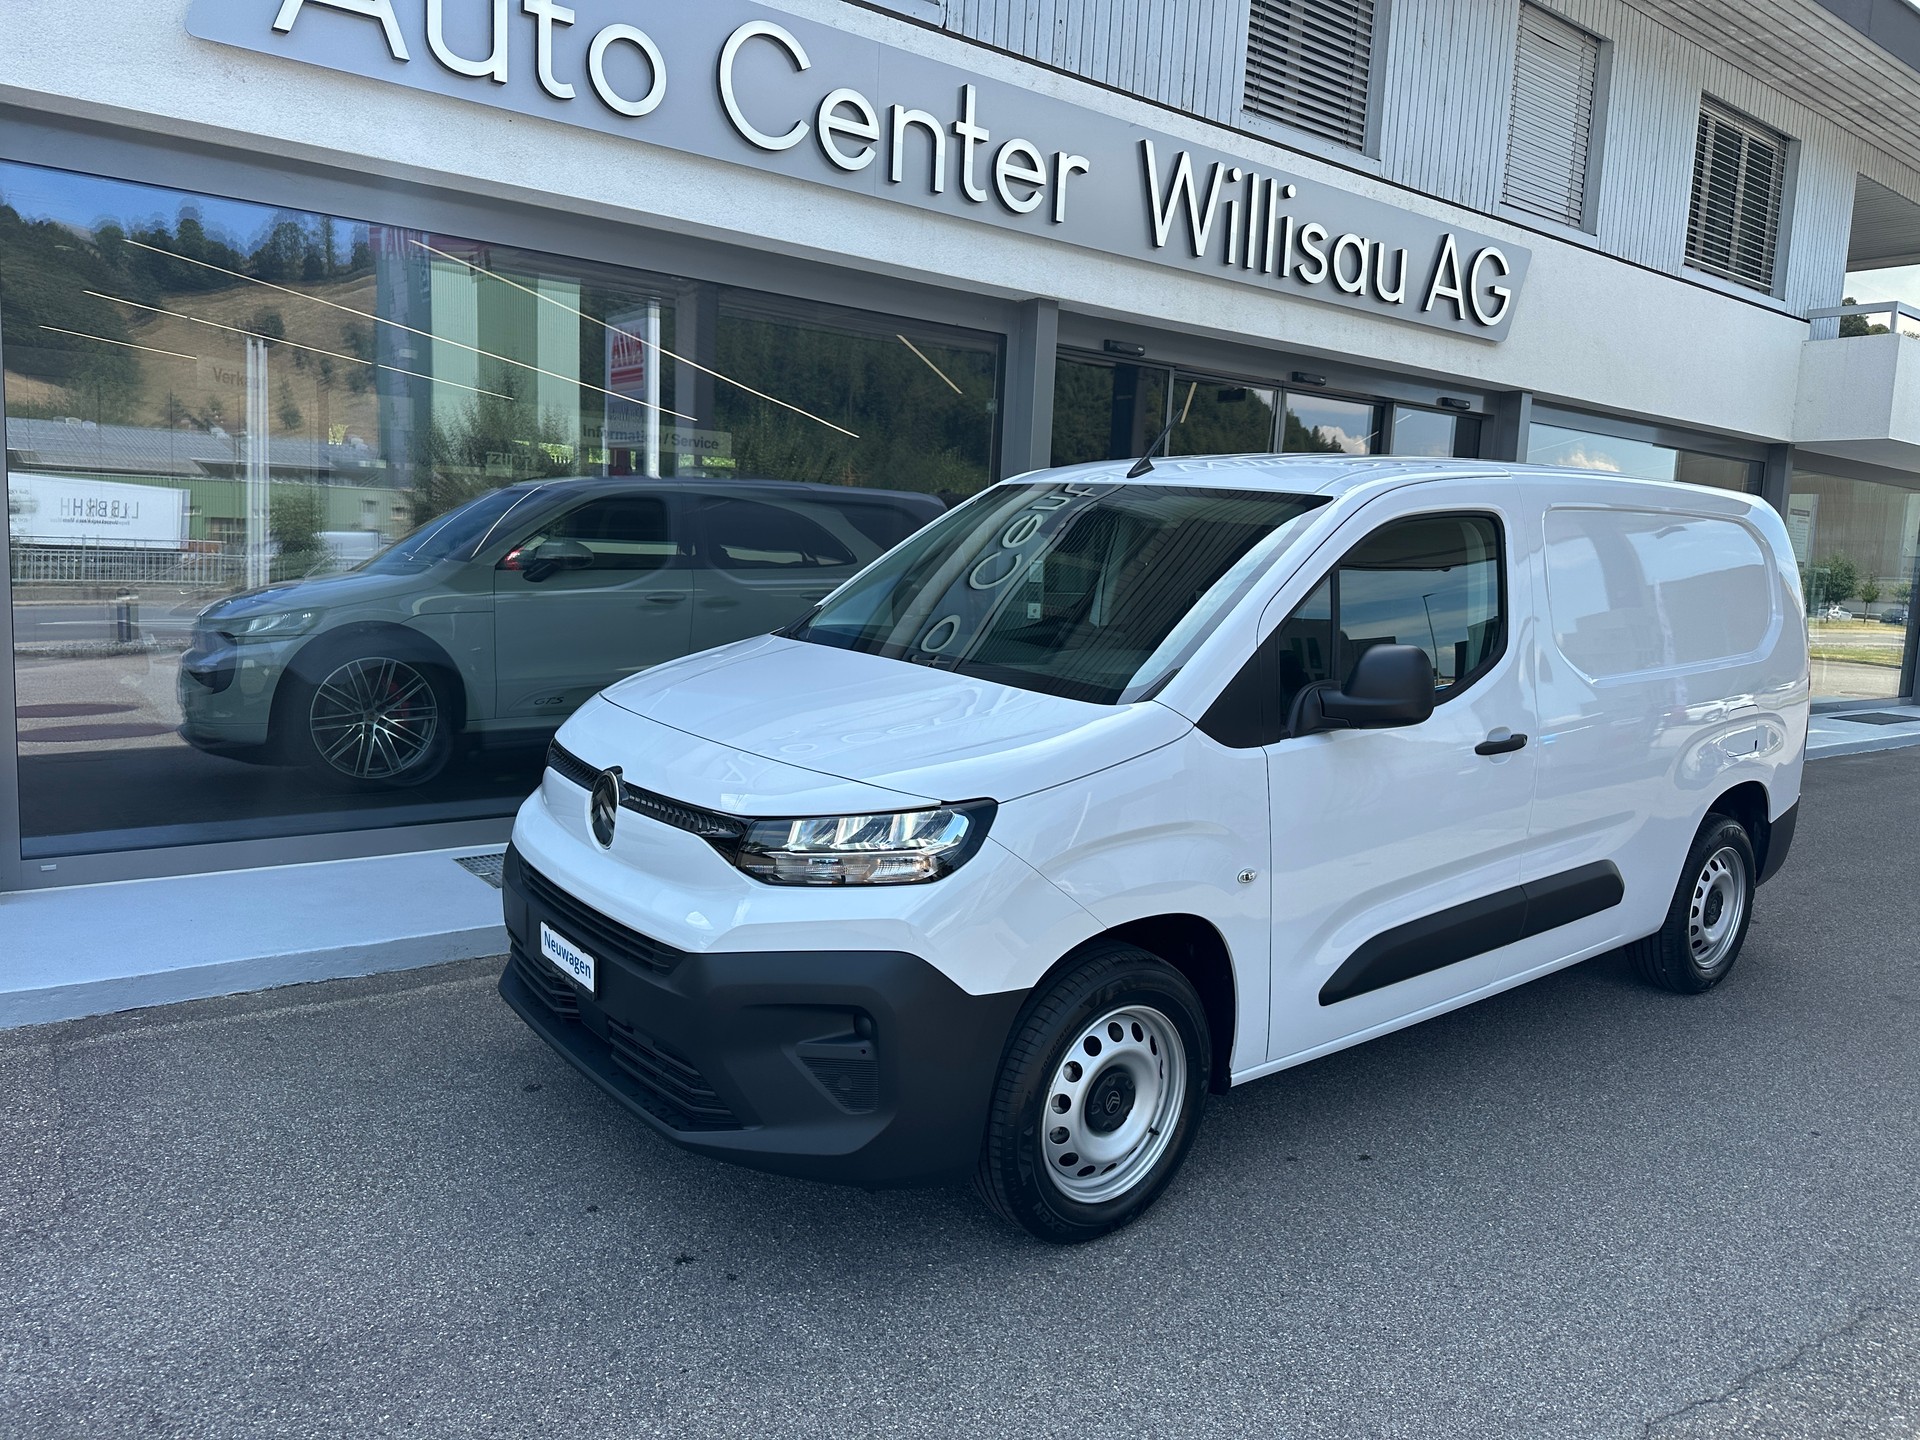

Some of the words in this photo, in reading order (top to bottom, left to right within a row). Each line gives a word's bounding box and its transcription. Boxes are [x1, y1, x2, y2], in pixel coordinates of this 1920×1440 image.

[716, 20, 1090, 223] Center
[1140, 139, 1408, 304] Willisau
[1421, 233, 1512, 326] AG
[583, 424, 660, 443] Infrmati
[672, 433, 719, 450] Service
[534, 696, 565, 706] GTS
[544, 930, 592, 979] Neuwagen
